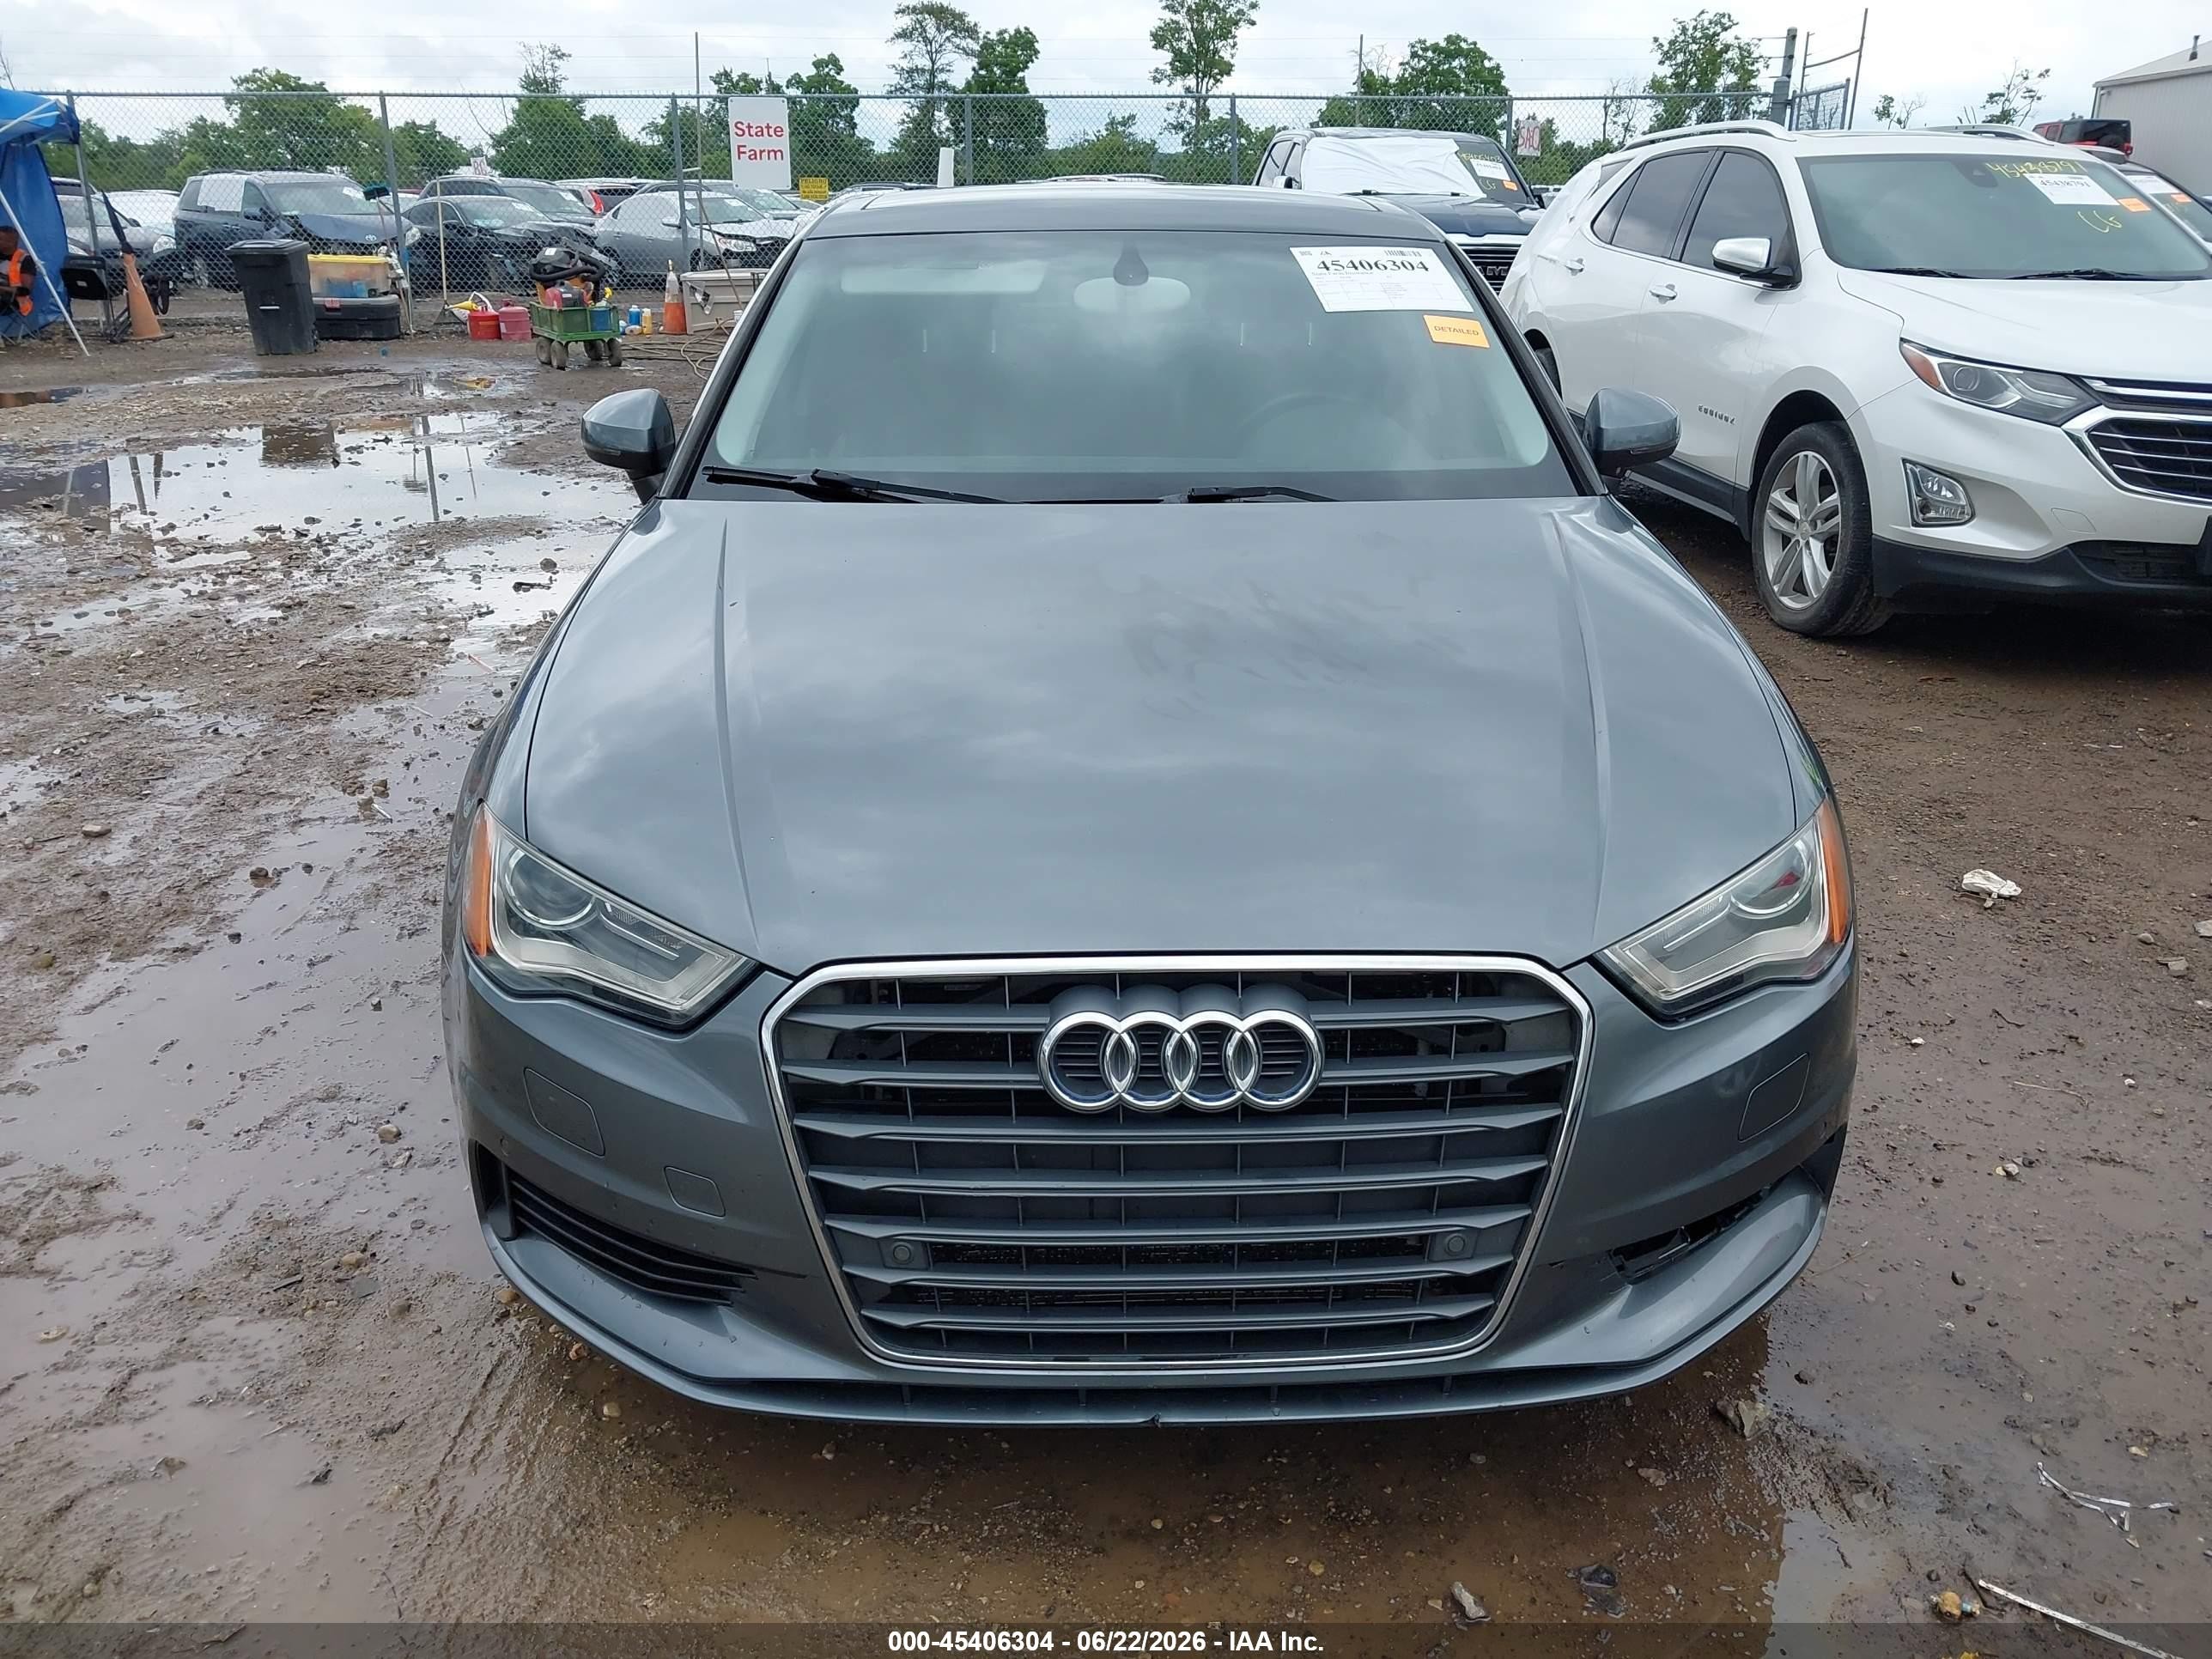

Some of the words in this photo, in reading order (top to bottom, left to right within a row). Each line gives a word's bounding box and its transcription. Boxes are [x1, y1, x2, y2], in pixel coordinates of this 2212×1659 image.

[734, 121, 784, 137] State
[737, 144, 784, 161] Farm
[1317, 259, 1430, 271] 45406304
[1433, 325, 1480, 337] DETAILED
